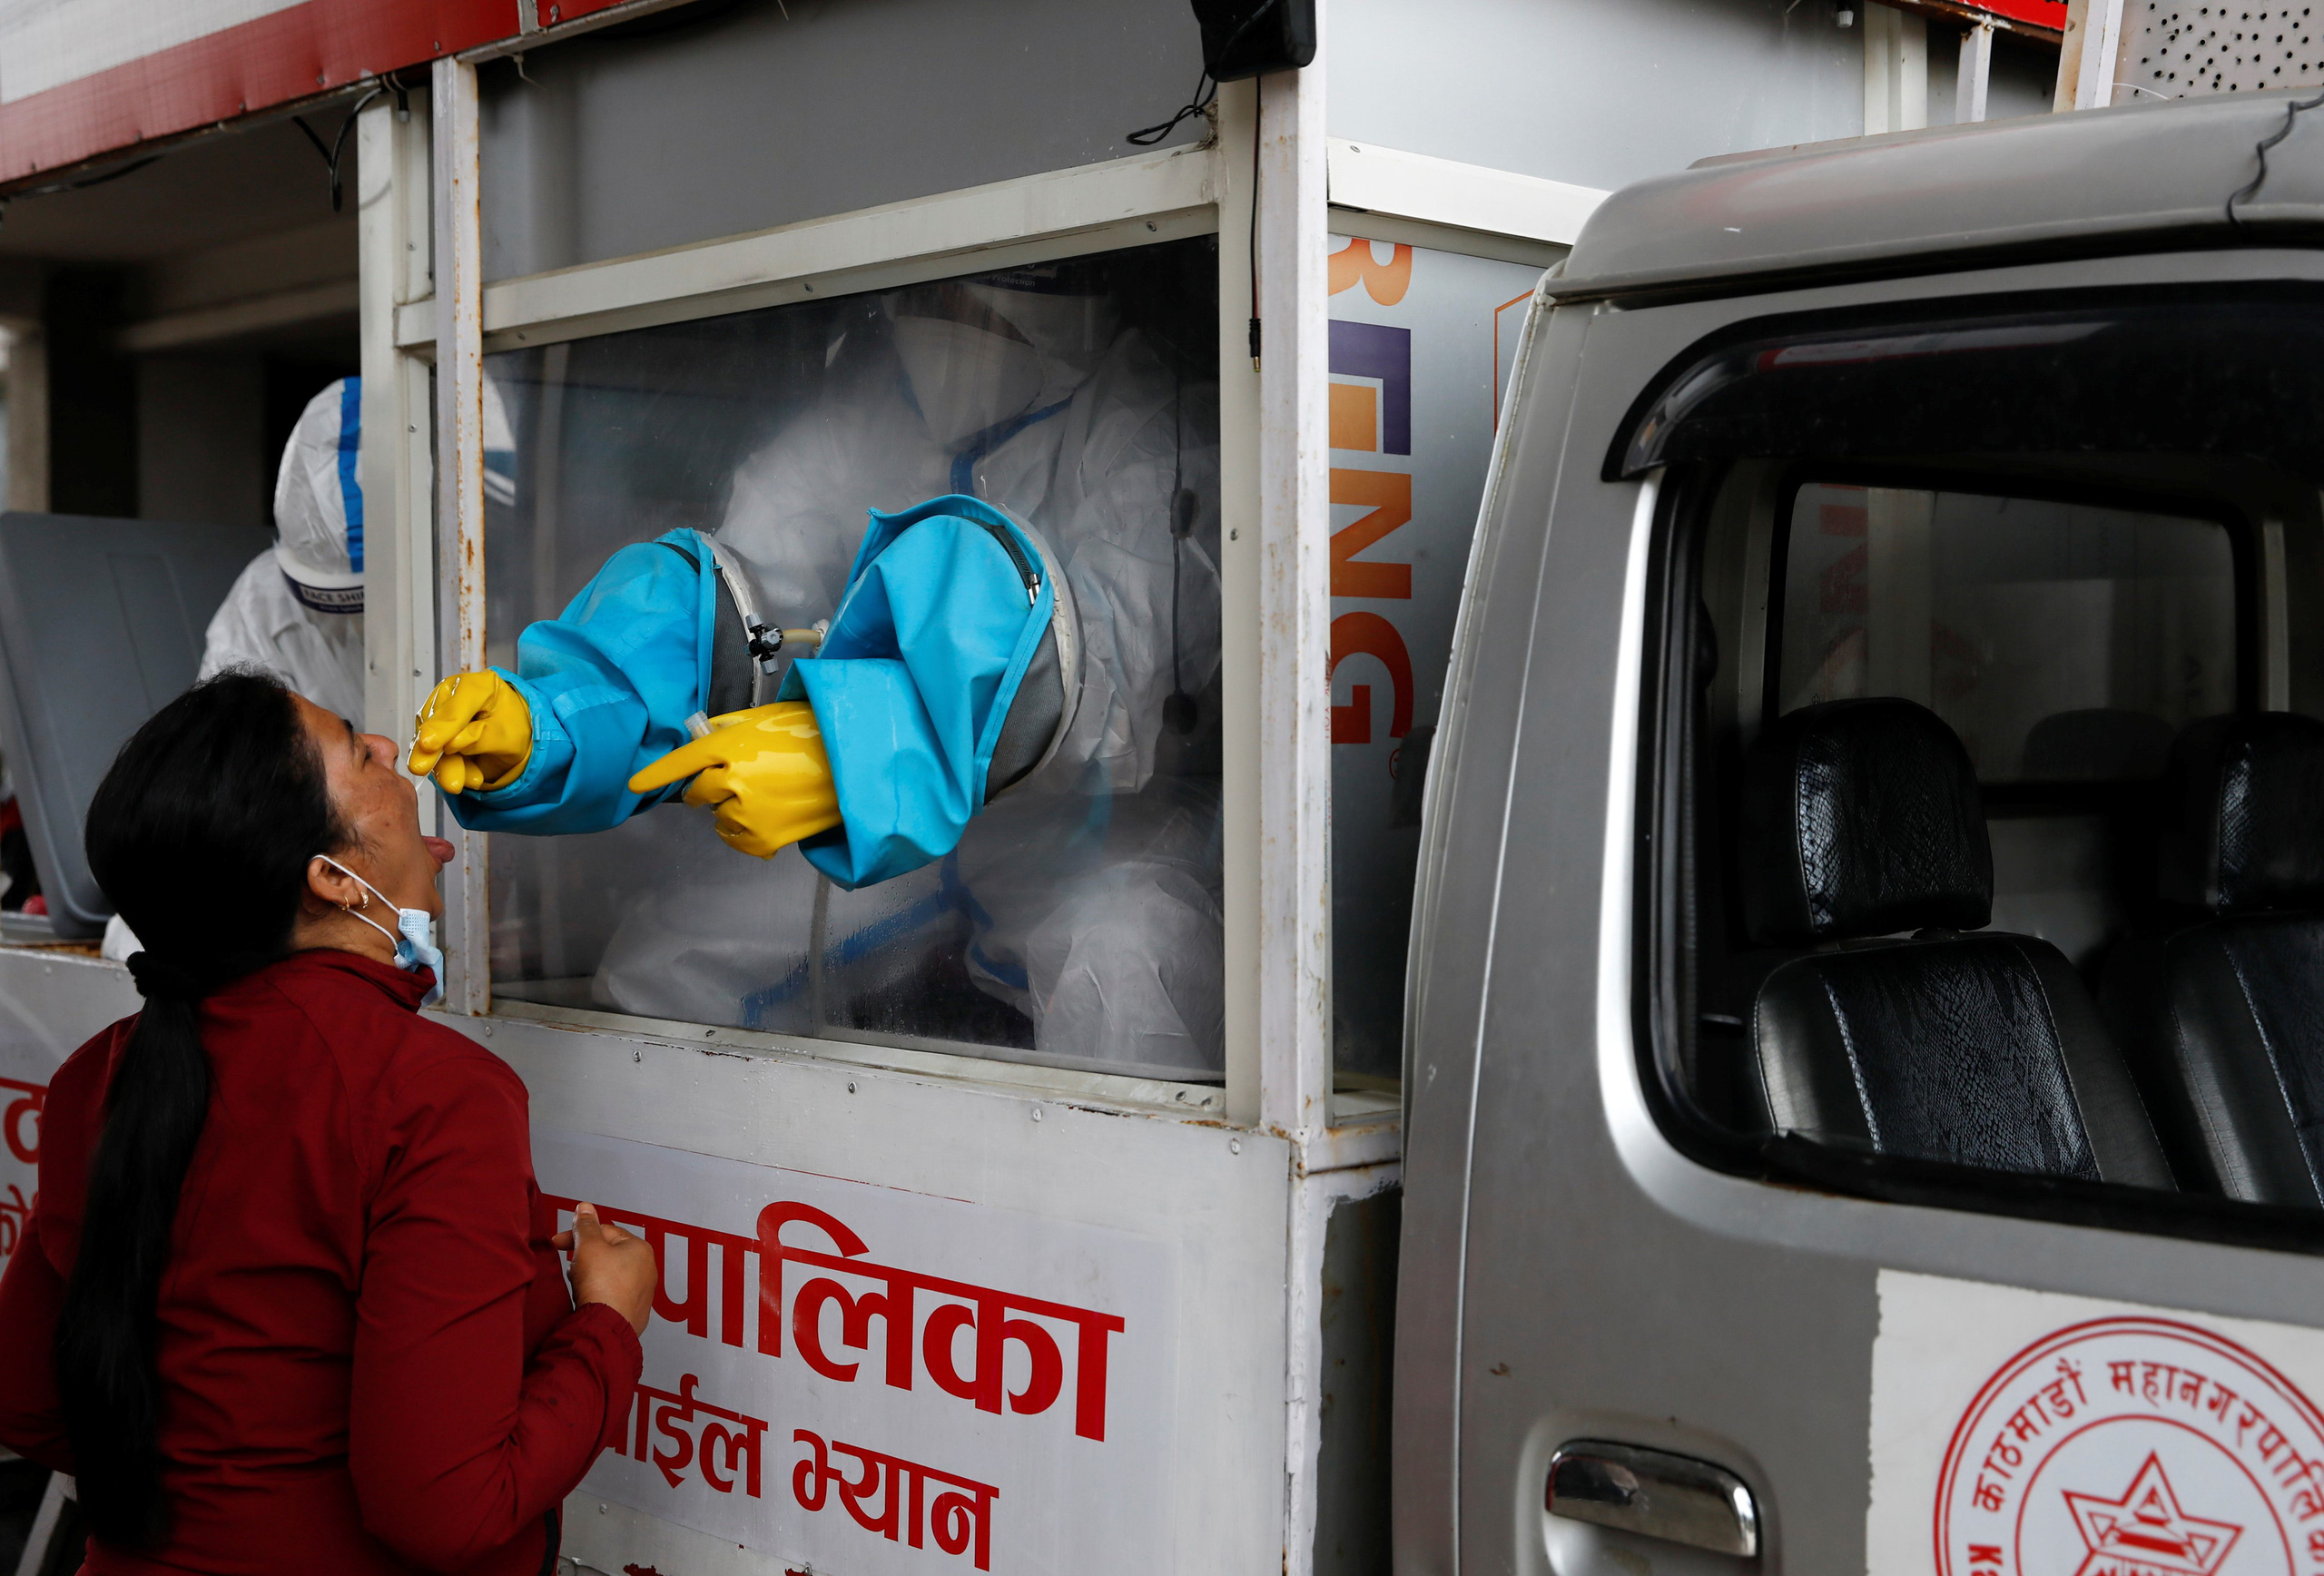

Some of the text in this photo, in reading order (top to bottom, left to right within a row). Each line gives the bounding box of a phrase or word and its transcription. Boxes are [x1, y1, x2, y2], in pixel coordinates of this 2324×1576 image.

[992, 274, 1036, 287] rotection
[337, 591, 364, 603] SHI
[541, 1193, 1125, 1442] पालिका
[792, 1428, 1000, 1572] भ्यान
[2107, 1361, 2324, 1576] महानगरपालि
